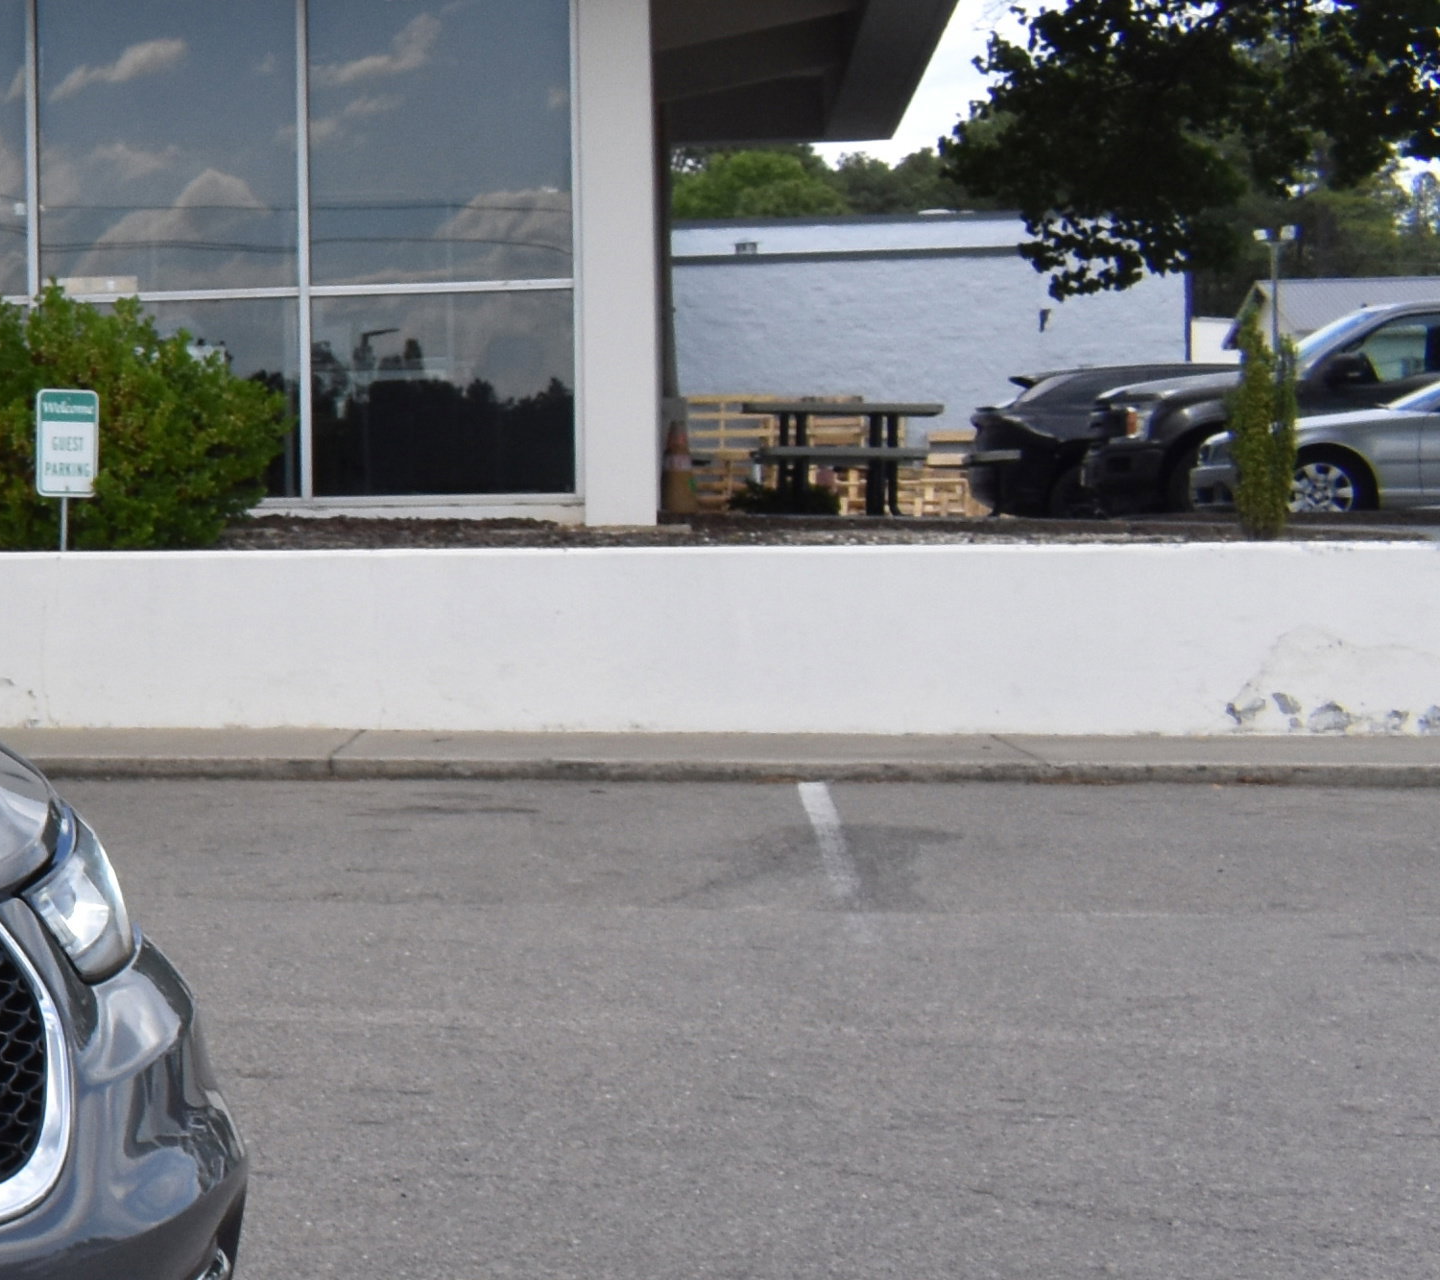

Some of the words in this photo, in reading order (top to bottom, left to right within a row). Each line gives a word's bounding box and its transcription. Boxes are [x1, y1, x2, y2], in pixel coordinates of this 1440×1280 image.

[42, 401, 94, 414] Welcome
[52, 436, 84, 451] GUEST
[45, 462, 90, 477] PARKING
